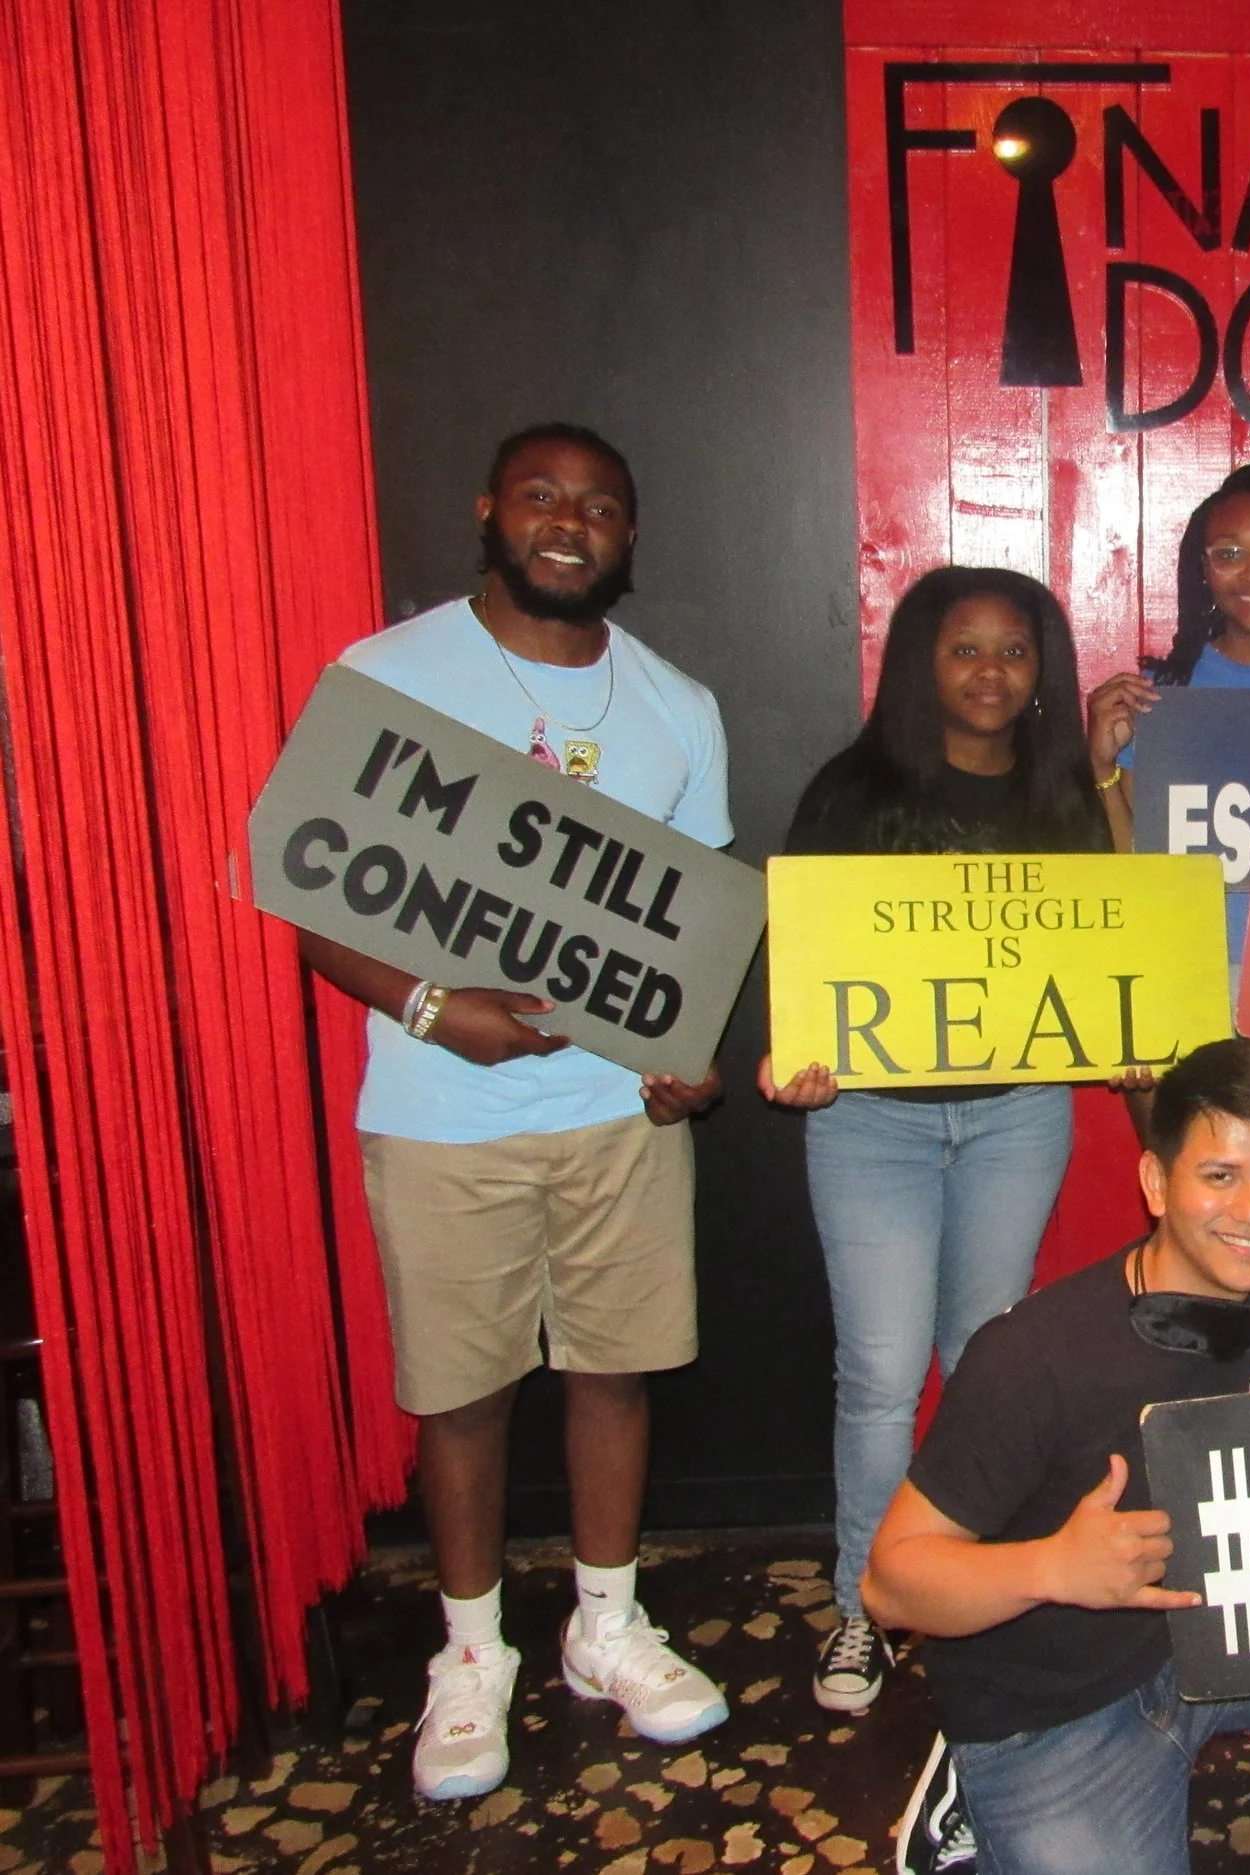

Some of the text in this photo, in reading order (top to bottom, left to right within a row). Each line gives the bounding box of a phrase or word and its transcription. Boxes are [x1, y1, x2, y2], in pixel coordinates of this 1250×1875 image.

[352, 726, 684, 941] I'M STILL
[953, 861, 1046, 894] THE
[281, 816, 684, 1039] CONFUSED
[872, 897, 1126, 933] STRUGGLE
[983, 936, 1022, 969] IS
[822, 973, 1180, 1077] REAL
